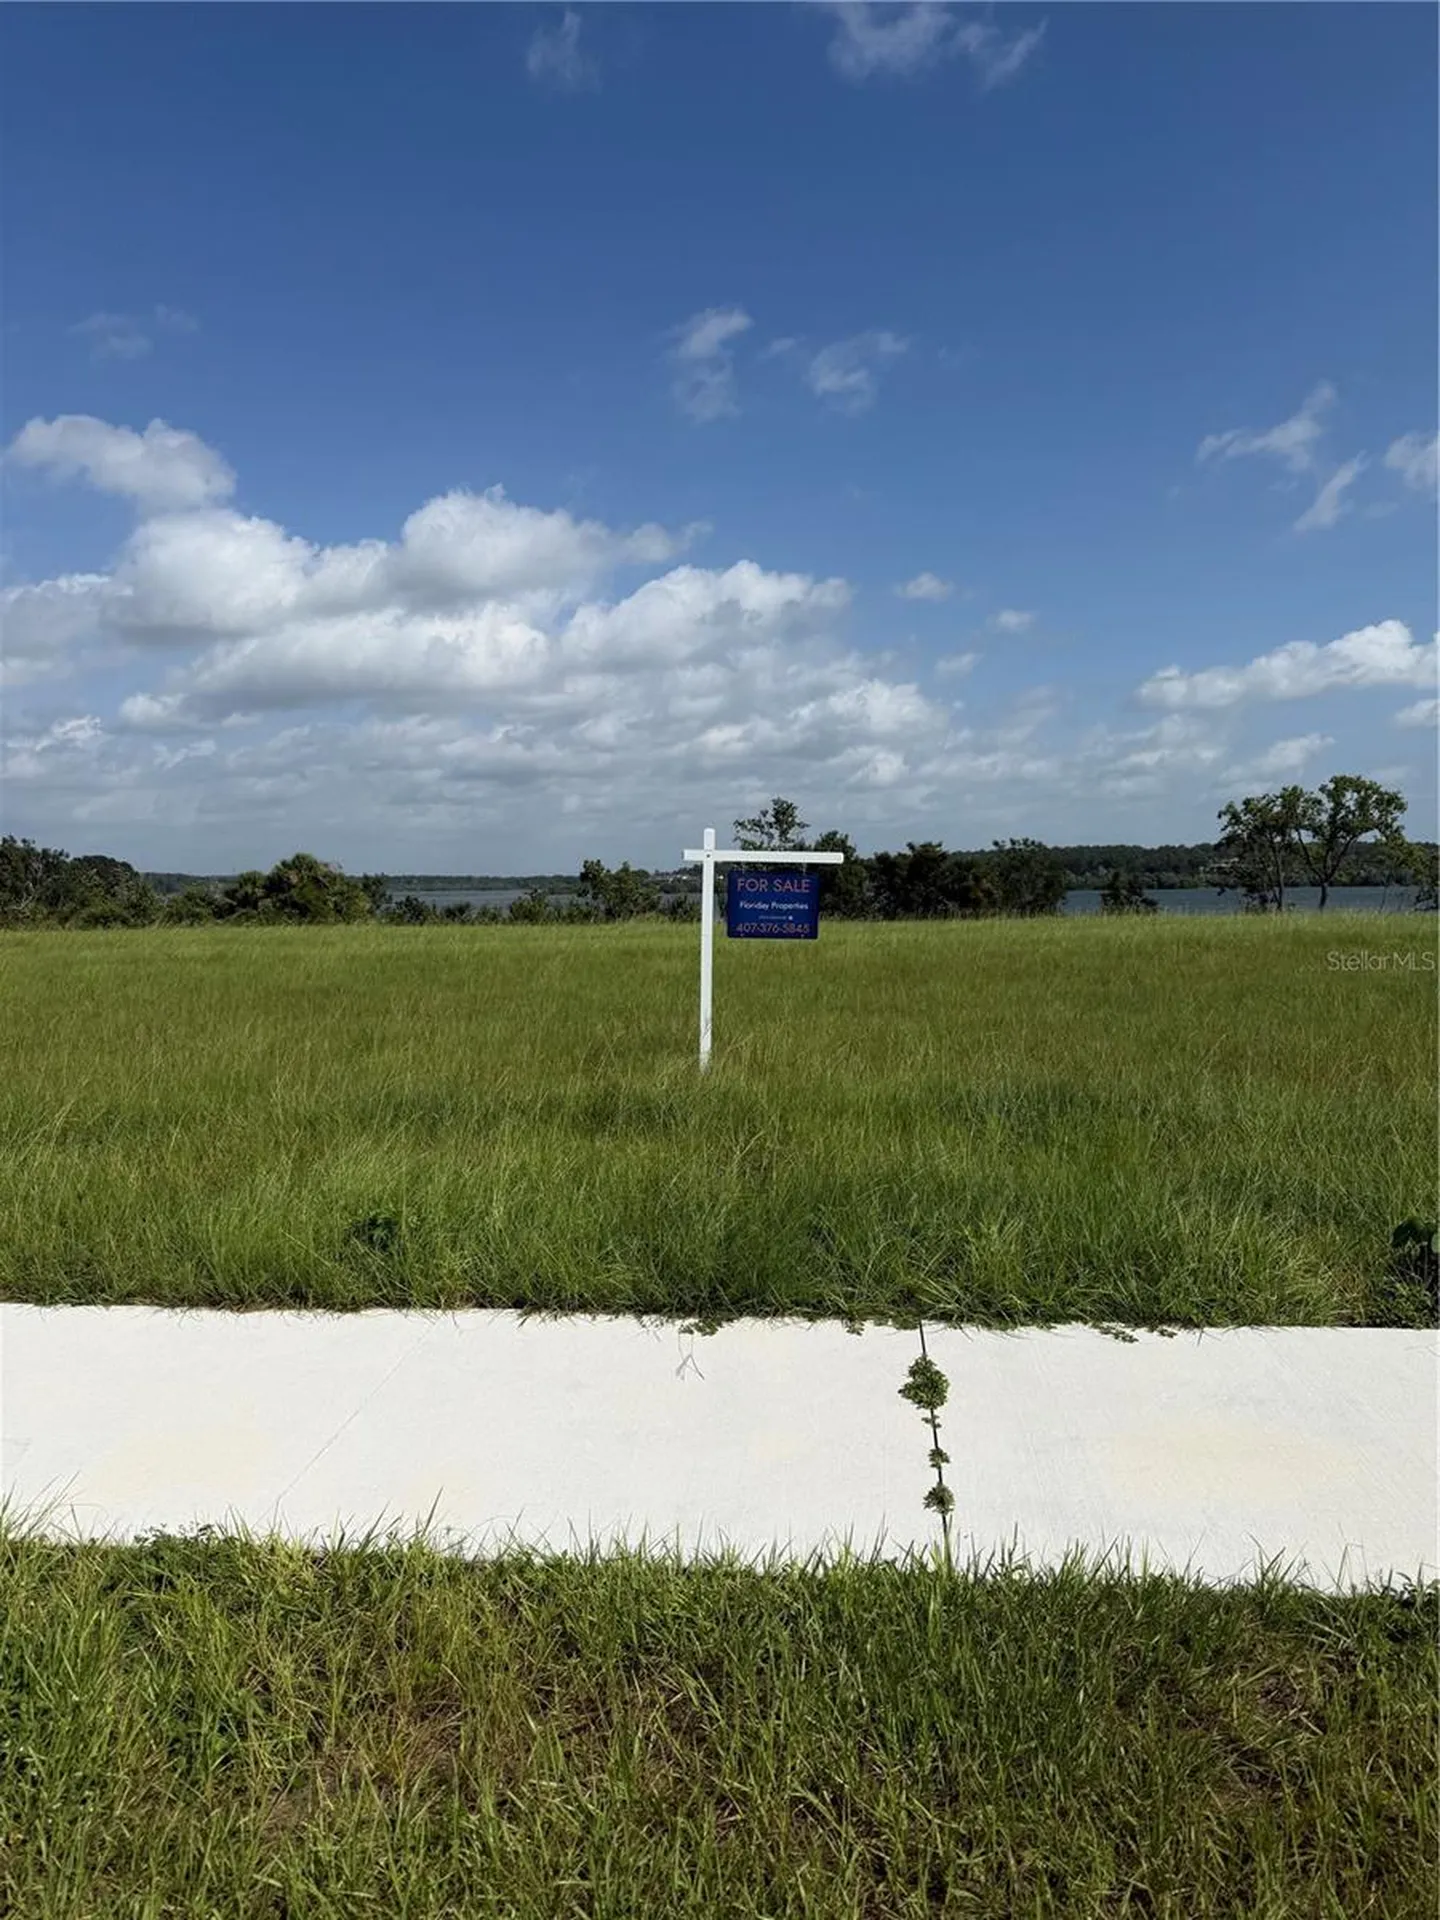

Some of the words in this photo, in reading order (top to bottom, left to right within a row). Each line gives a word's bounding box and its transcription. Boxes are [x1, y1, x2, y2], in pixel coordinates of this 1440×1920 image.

[737, 878, 768, 893] FOR
[773, 879, 811, 893] SALE
[771, 901, 809, 910] Properties
